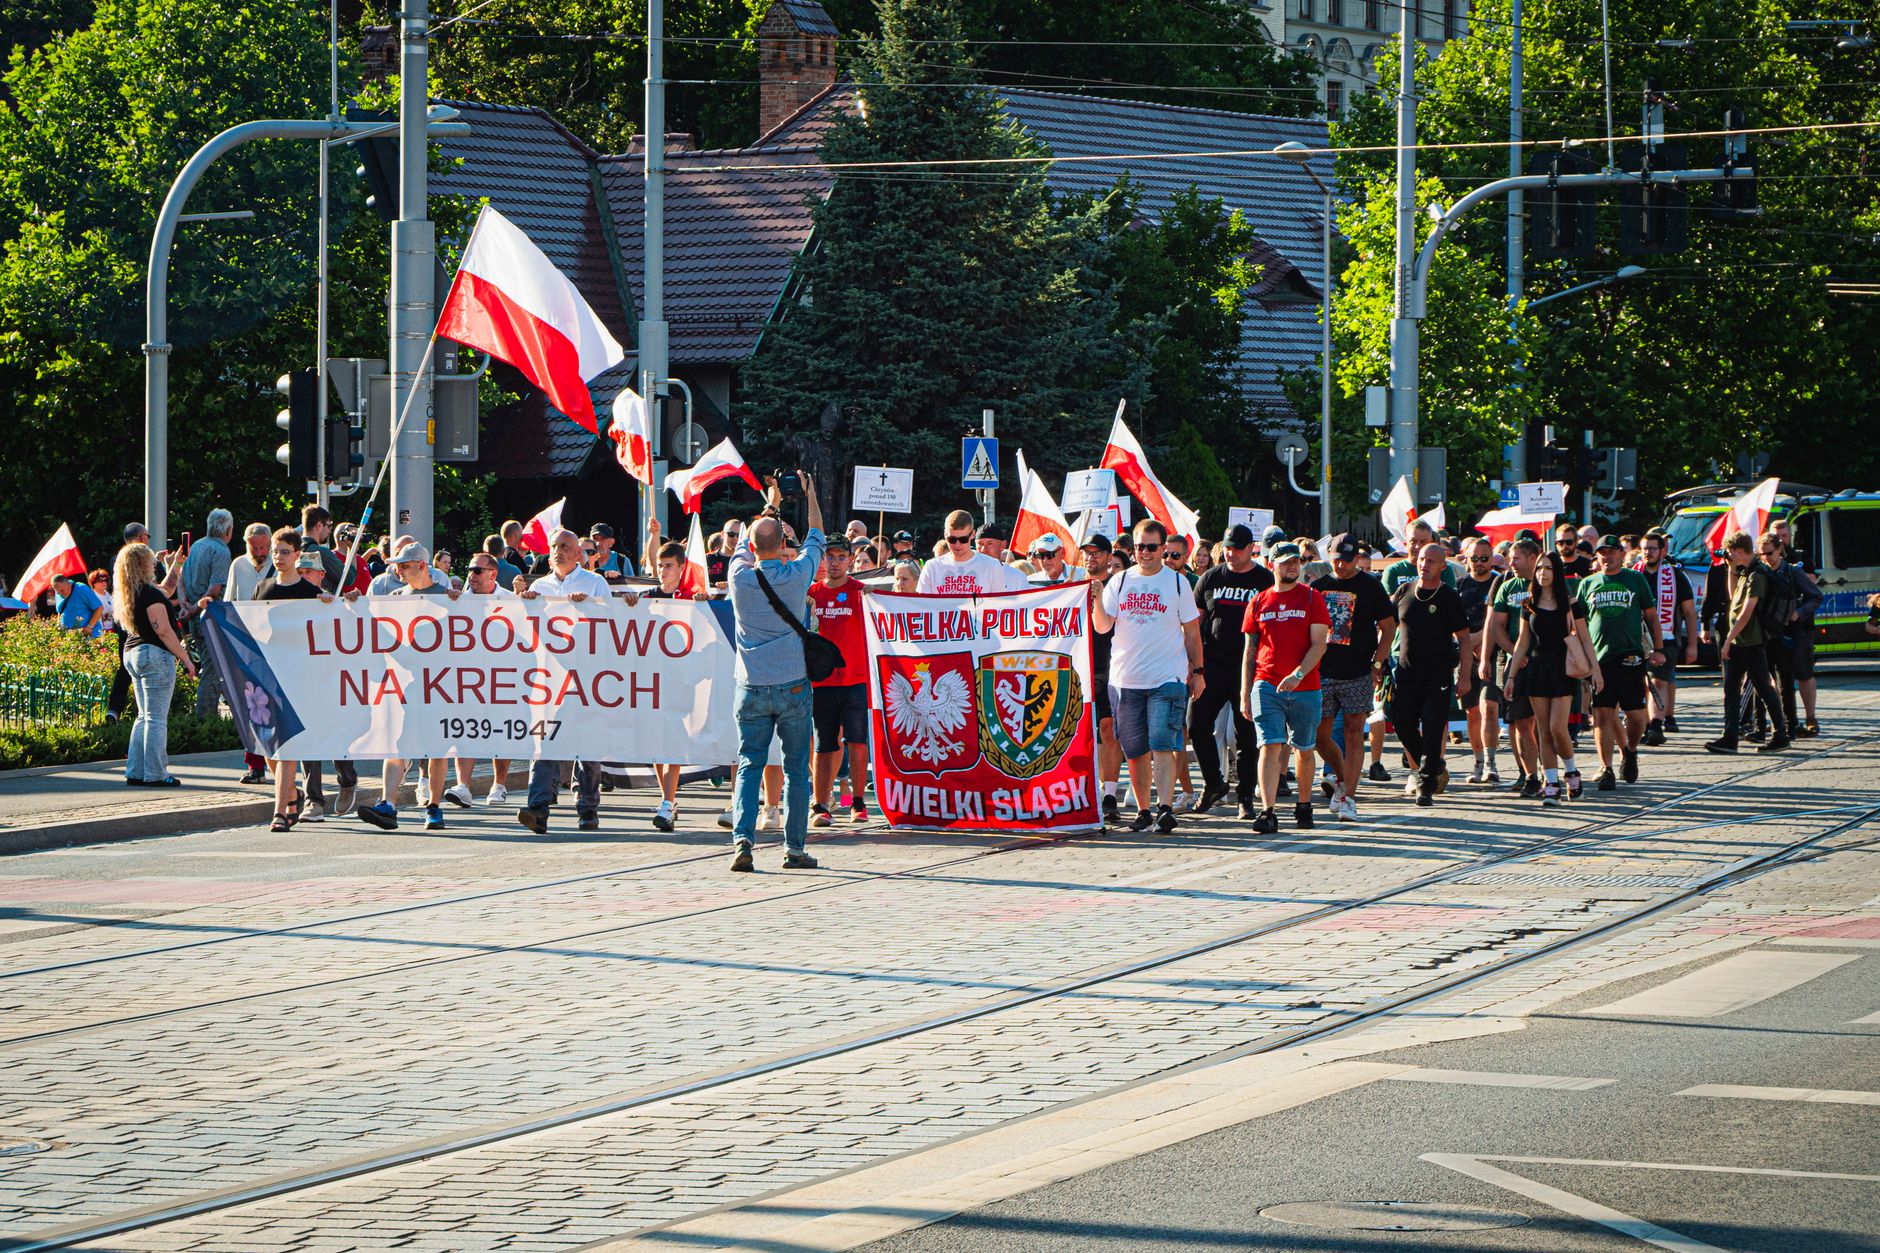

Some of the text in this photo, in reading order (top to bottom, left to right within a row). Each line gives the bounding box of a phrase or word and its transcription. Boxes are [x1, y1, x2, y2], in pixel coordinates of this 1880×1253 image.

[1660, 565, 1673, 625] WIELKA
[1854, 595, 1868, 609] POL
[306, 607, 694, 657] LUDOBÓJSTWO
[870, 606, 1083, 642] WIELKA POLSKA
[338, 666, 661, 710] NA KRESACH
[439, 717, 562, 741] 1939-1947
[884, 777, 987, 822] WIELKI
